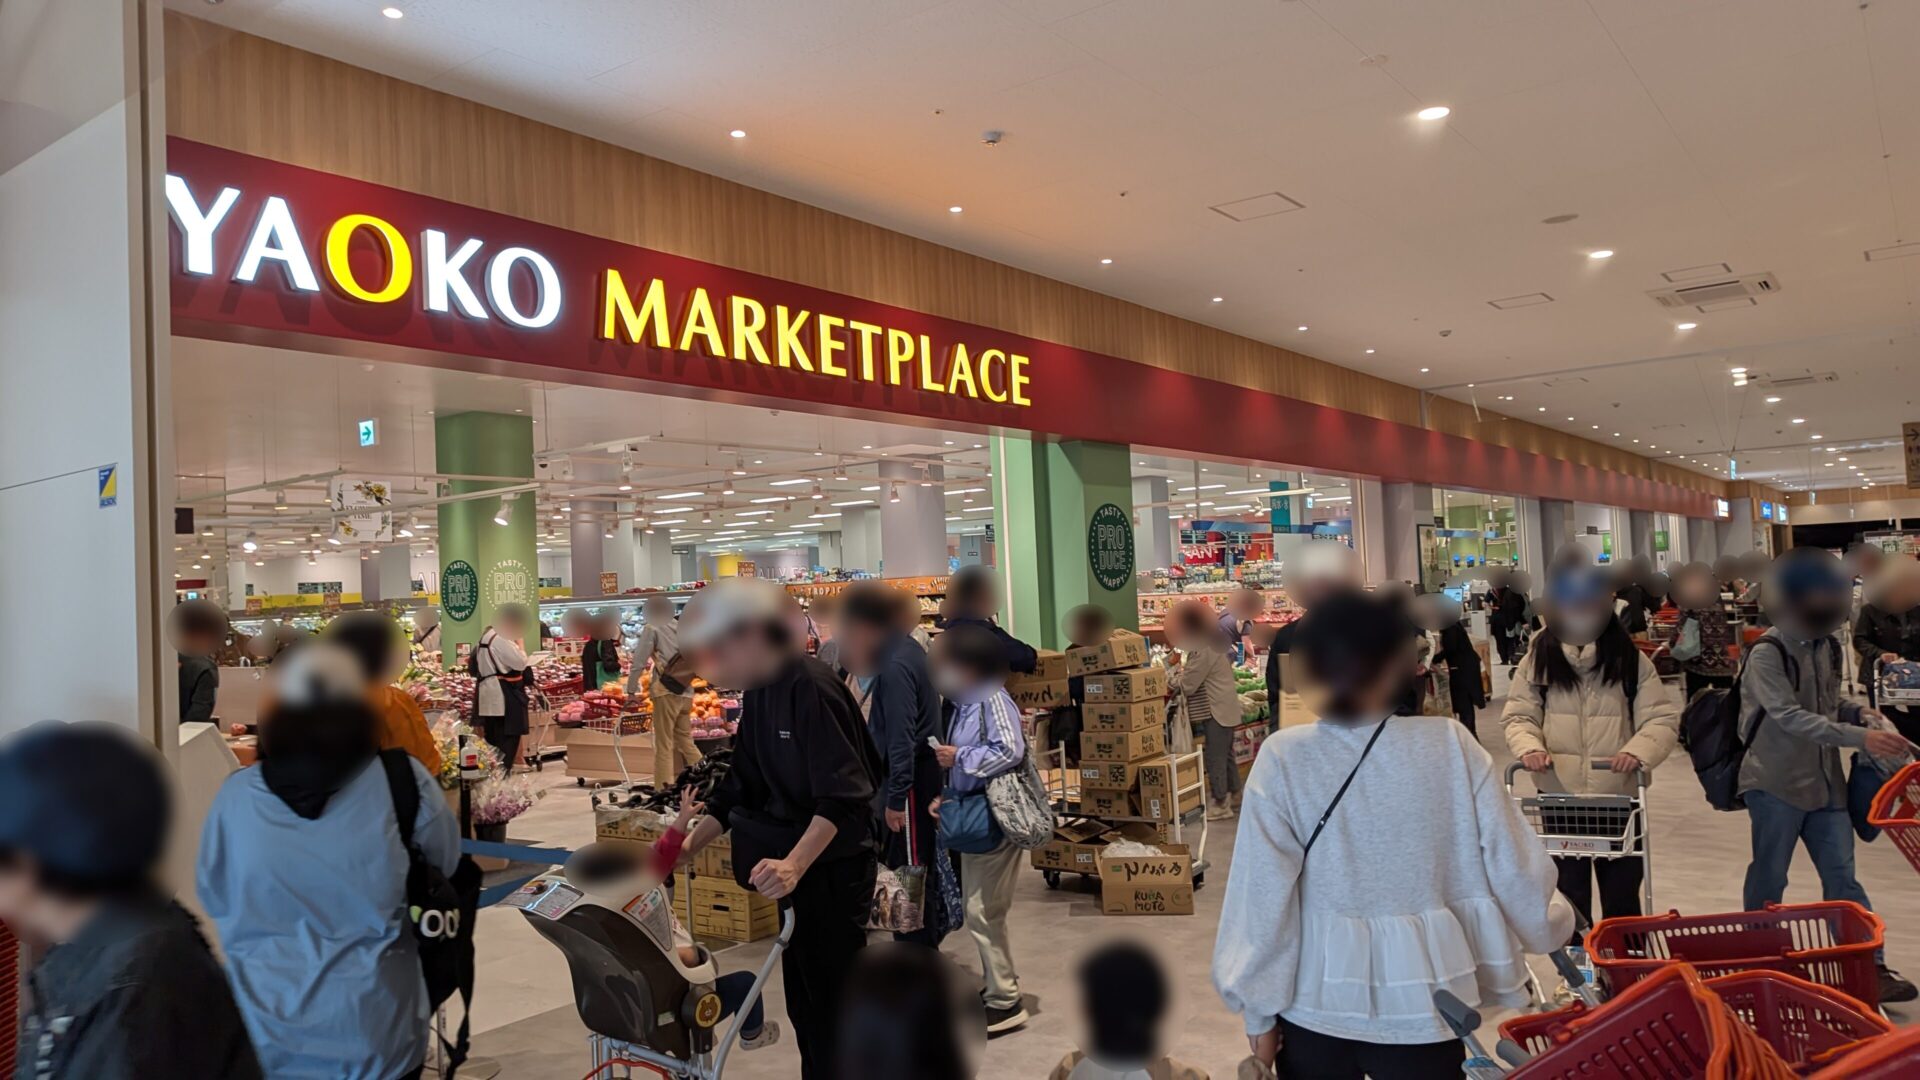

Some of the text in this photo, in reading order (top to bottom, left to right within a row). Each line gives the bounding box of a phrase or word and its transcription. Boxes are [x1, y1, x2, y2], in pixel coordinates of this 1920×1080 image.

[165, 173, 1032, 407] YAOKO MARKETPLACE
[1100, 507, 1121, 519] TASTY
[1097, 524, 1126, 550] PRO
[449, 562, 468, 572] TASTY
[497, 560, 522, 569] TASTY
[1099, 550, 1127, 570] DUCE
[448, 574, 471, 592] PRO
[493, 572, 526, 591] PRO
[1103, 574, 1125, 588] HAPPY
[448, 592, 471, 607] DUCE
[494, 590, 527, 605] DUCE
[451, 609, 470, 619] HAPPY
[1134, 891, 1164, 901] KUMA
[1134, 901, 1165, 912] MOTO
